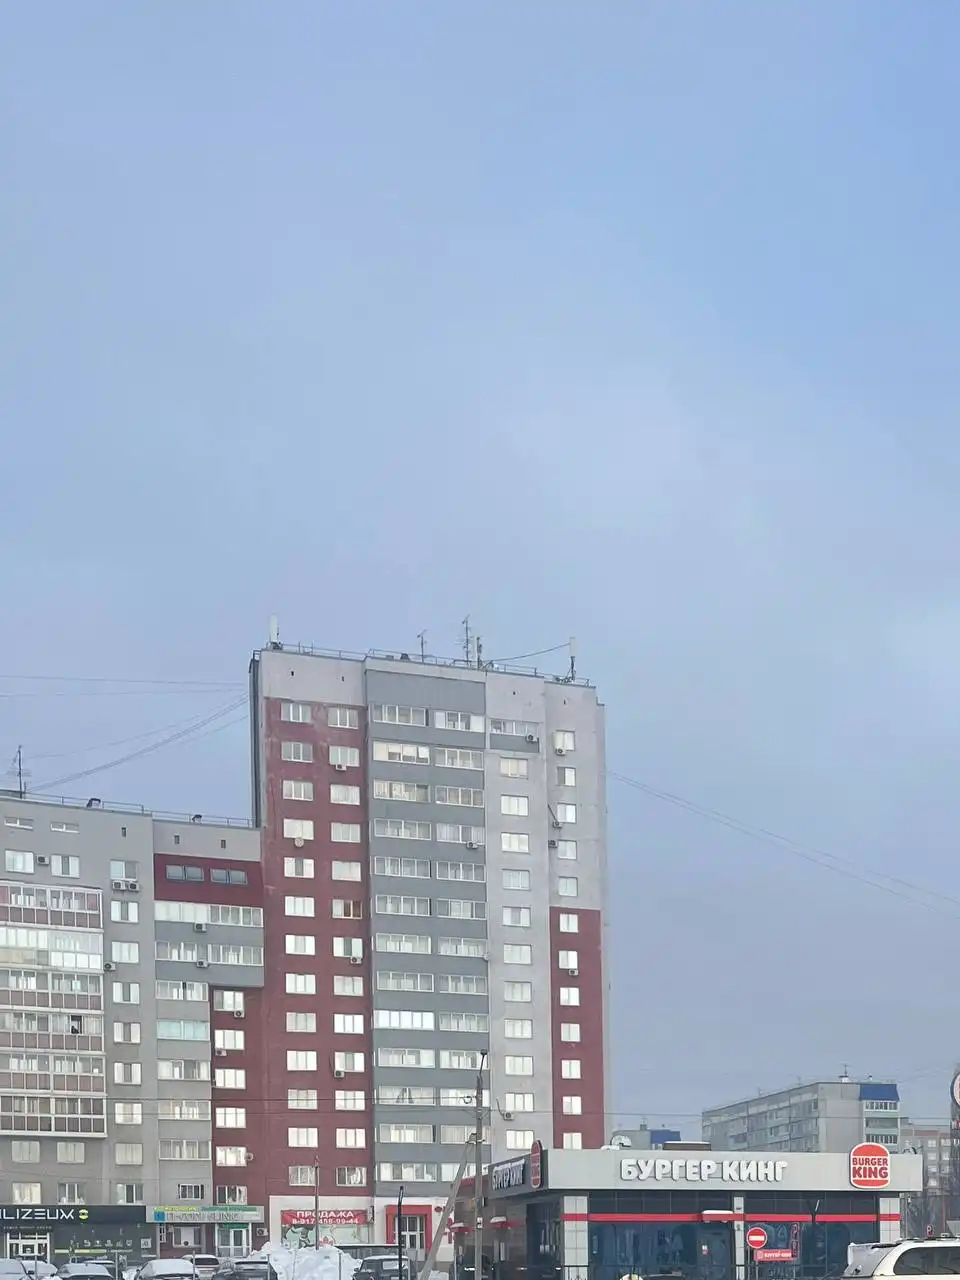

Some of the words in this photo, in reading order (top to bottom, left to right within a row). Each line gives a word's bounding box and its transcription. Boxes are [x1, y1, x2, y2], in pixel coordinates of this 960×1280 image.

[852, 1157, 889, 1166] BURGER
[621, 1158, 718, 1181] БУРГЕР
[722, 1159, 788, 1182] КИНГ
[852, 1166, 889, 1179] KING
[296, 1210, 354, 1219] ПРОДАЖА
